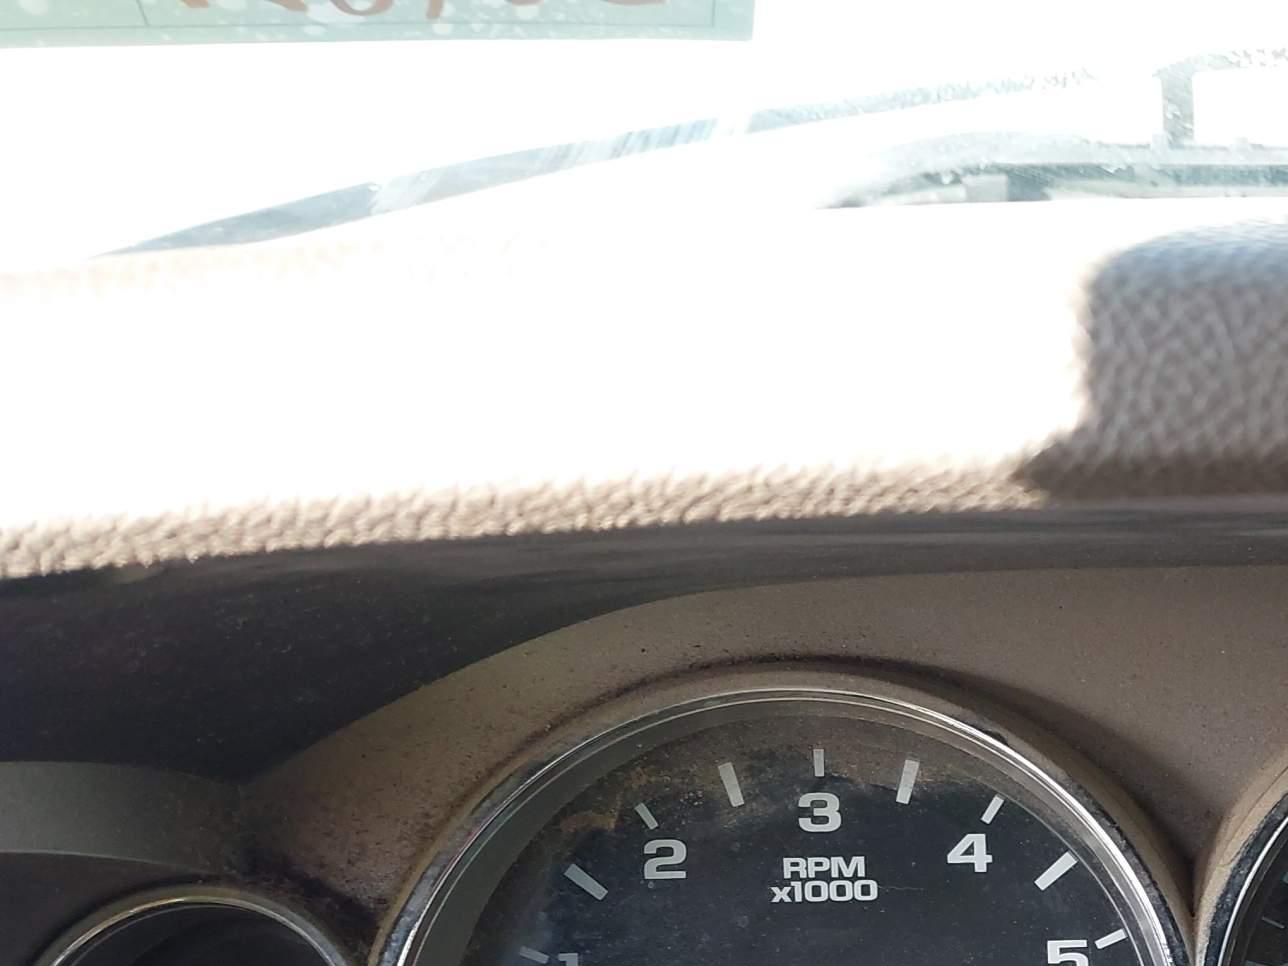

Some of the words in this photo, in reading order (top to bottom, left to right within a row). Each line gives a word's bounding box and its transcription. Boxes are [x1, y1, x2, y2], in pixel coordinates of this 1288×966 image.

[798, 792, 842, 833] 3
[643, 839, 687, 879] 2
[782, 856, 866, 879] RPM
[947, 833, 992, 872] 4
[771, 879, 878, 903] x1000
